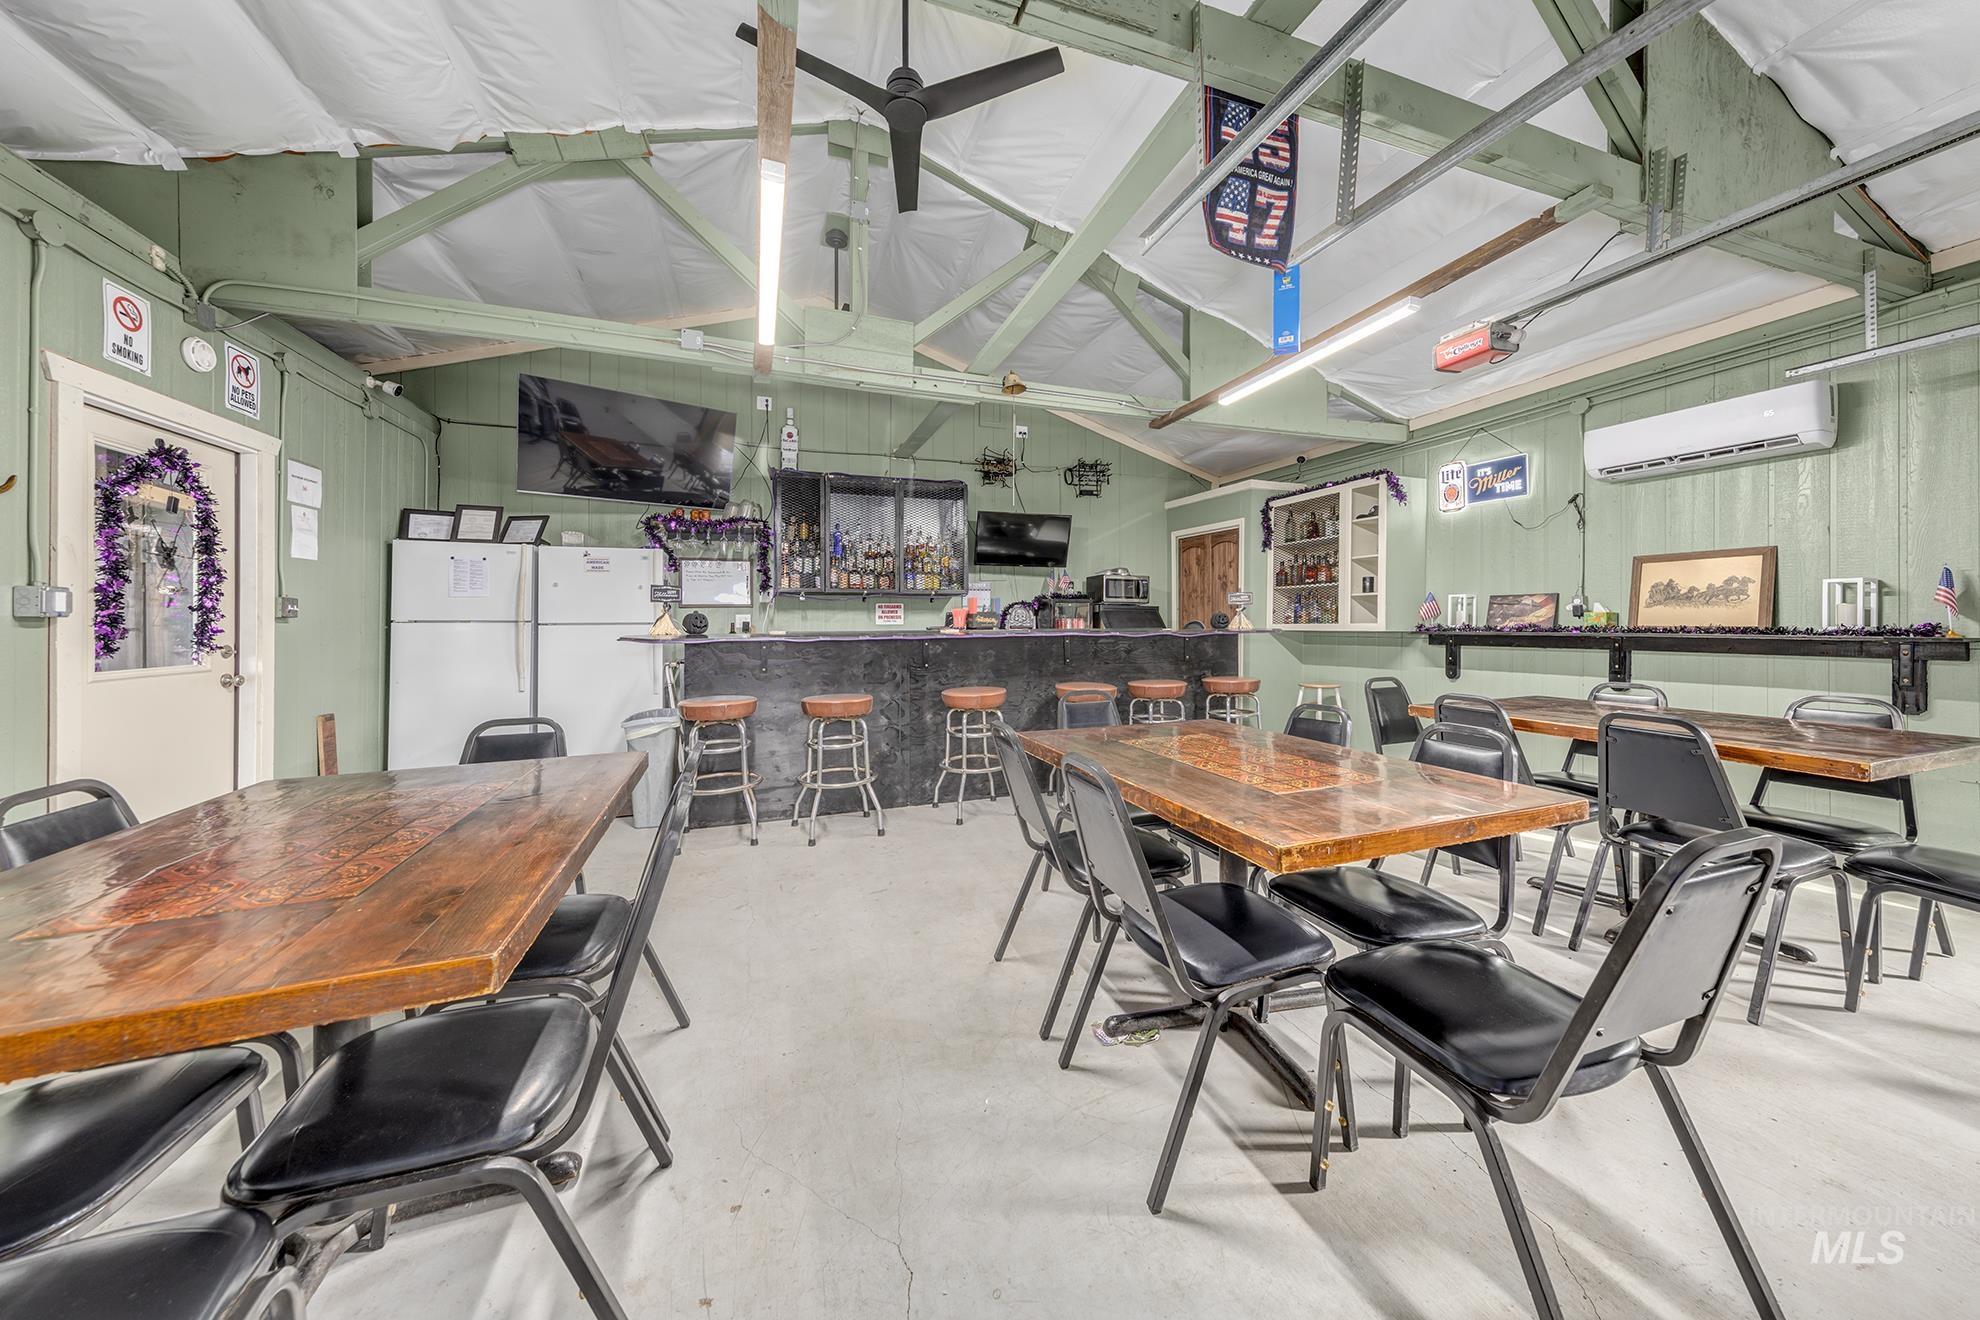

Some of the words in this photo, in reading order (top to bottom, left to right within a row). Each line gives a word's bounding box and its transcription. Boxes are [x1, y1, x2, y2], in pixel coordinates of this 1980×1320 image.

[1234, 165, 1258, 179] AMERICA
[1258, 170, 1274, 183] GREAT
[1273, 175, 1294, 188] AGAIN!
[1215, 177, 1289, 250] 47
[123, 333, 134, 348] NO
[111, 342, 144, 366] SMOKING
[231, 384, 240, 396] NO
[241, 388, 255, 401] PETS
[230, 393, 256, 411] ALLOWED
[1441, 469, 1462, 484] Lite
[1468, 466, 1522, 496] Miller
[1494, 479, 1522, 493] TIME
